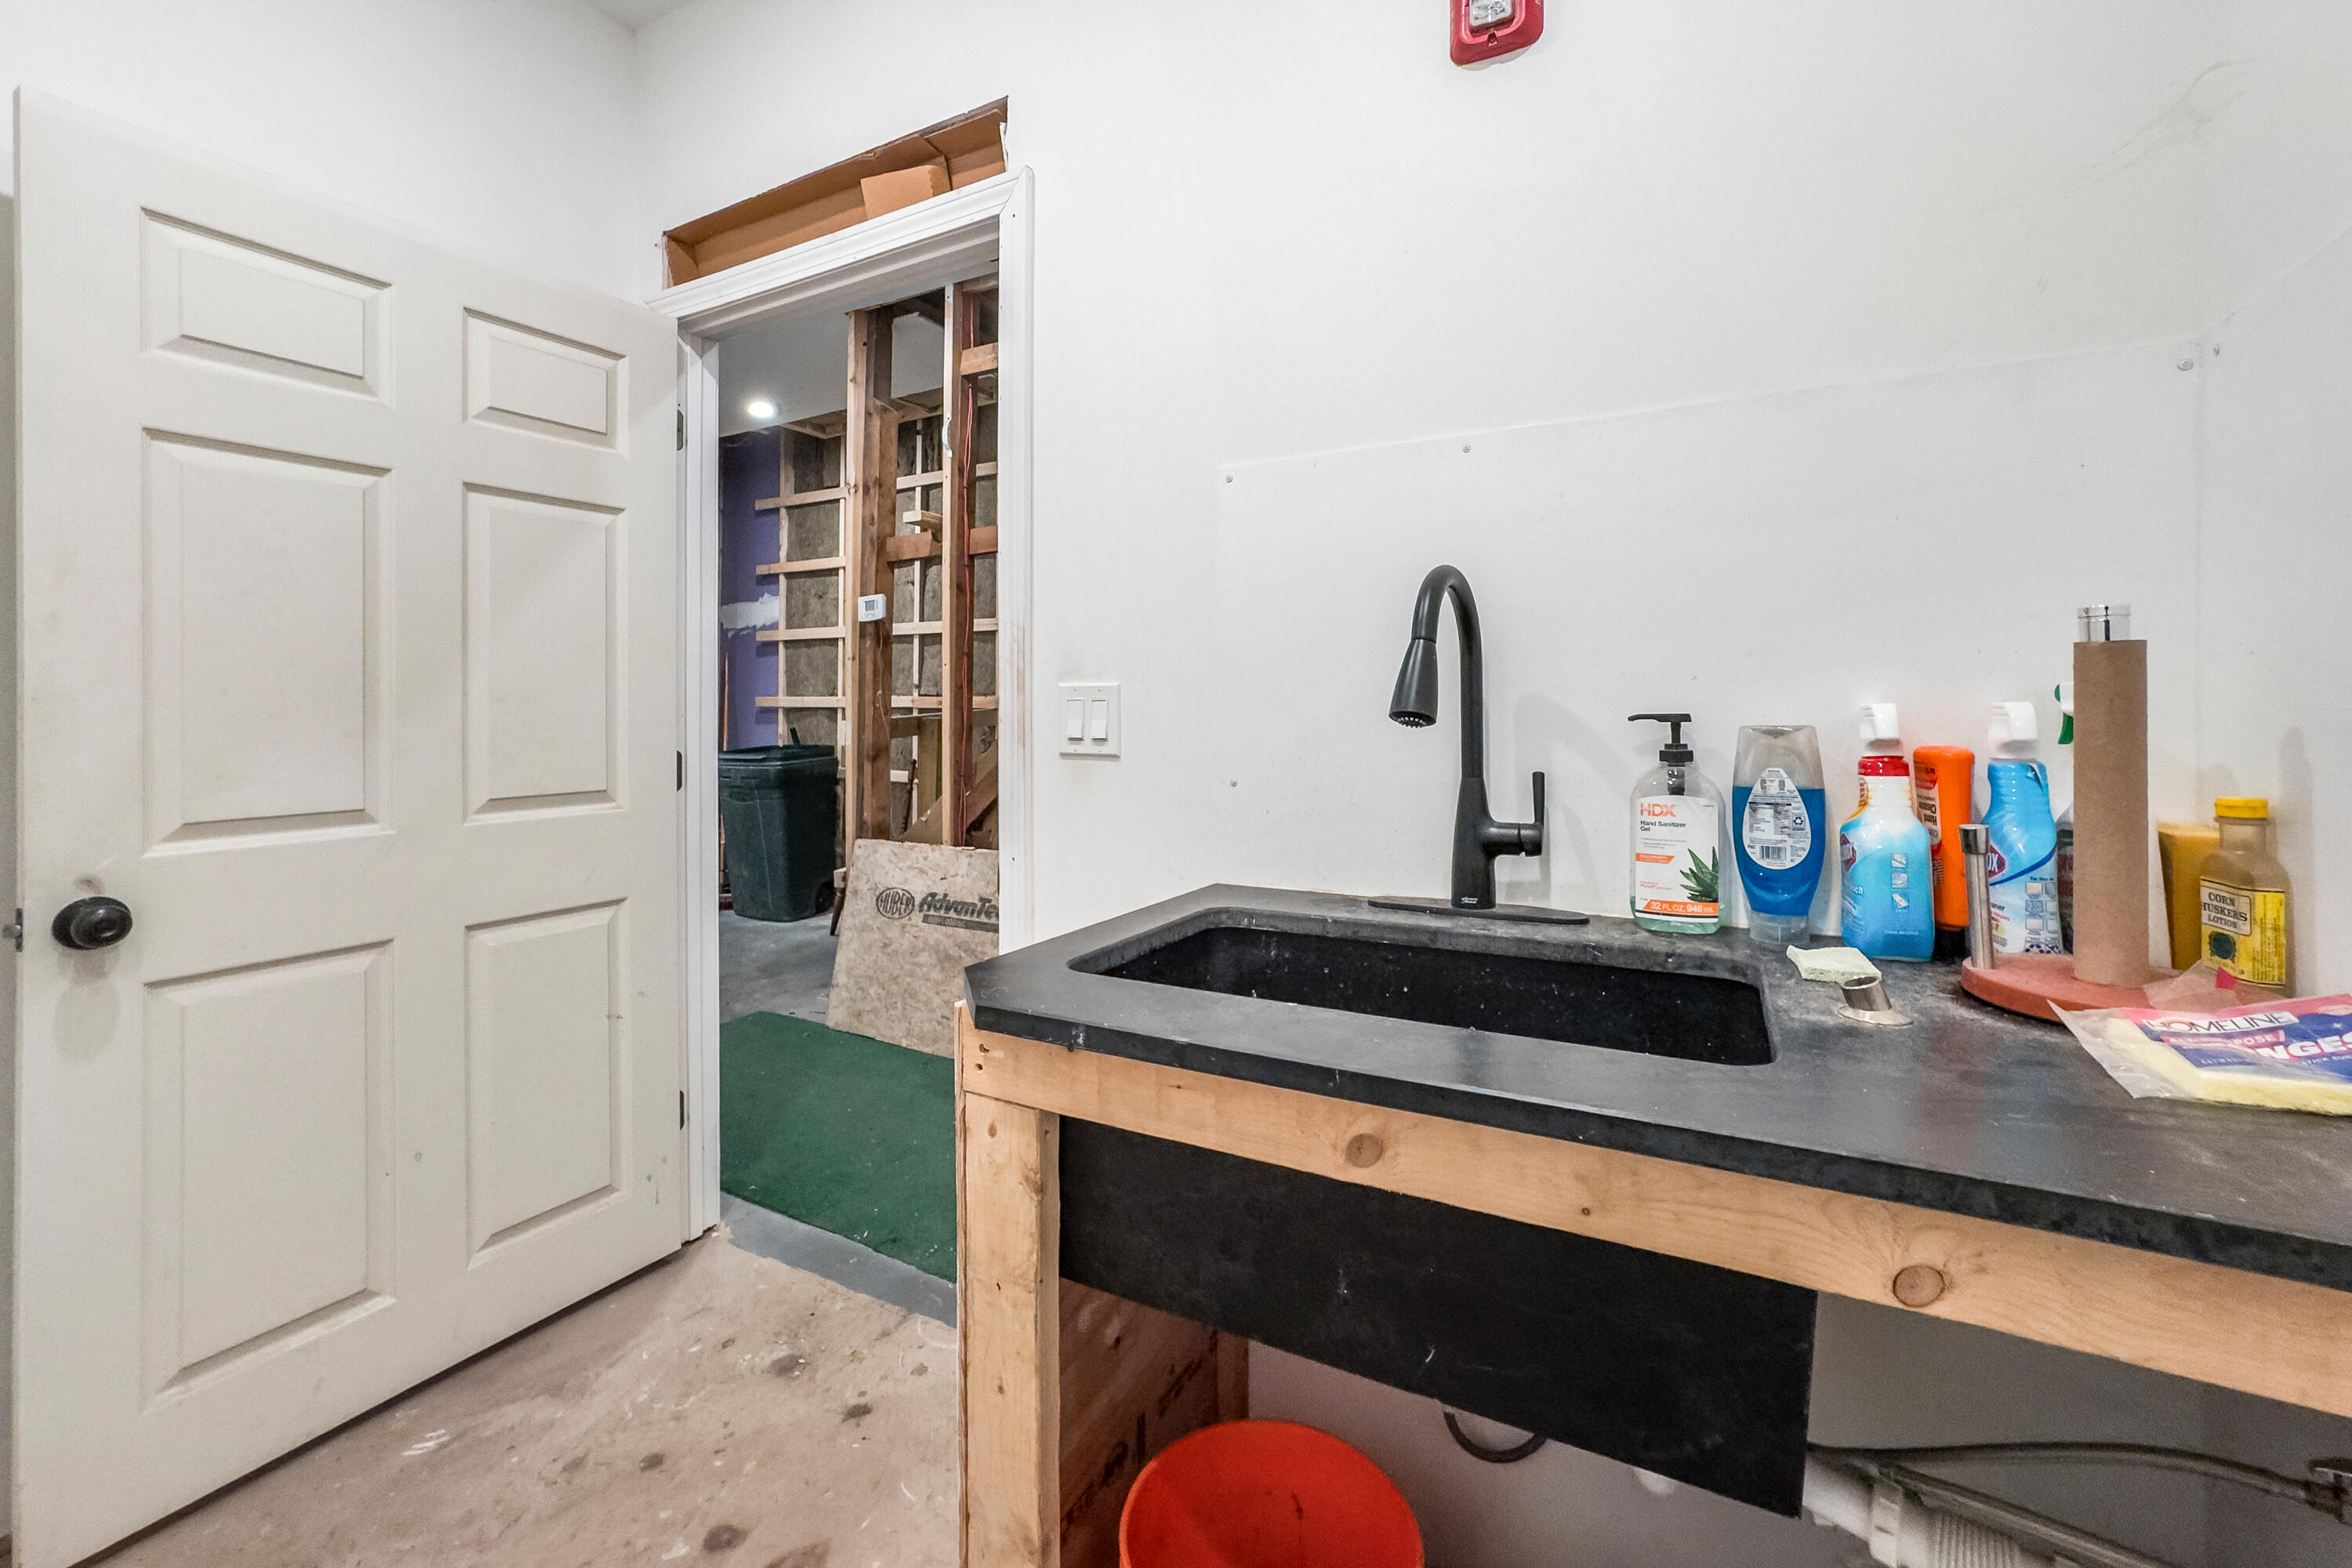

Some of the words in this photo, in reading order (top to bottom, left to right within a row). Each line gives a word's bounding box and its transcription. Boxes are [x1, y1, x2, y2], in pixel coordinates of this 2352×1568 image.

[1640, 803, 1676, 817] HDX
[880, 891, 913, 916] HUBER
[918, 891, 999, 921] AdvanTe
[2208, 891, 2235, 907] CORN
[1650, 902, 1661, 910] 32
[1686, 904, 1703, 913] 946
[2208, 913, 2237, 929] LOTION
[2145, 1012, 2294, 1033] HOMELINE
